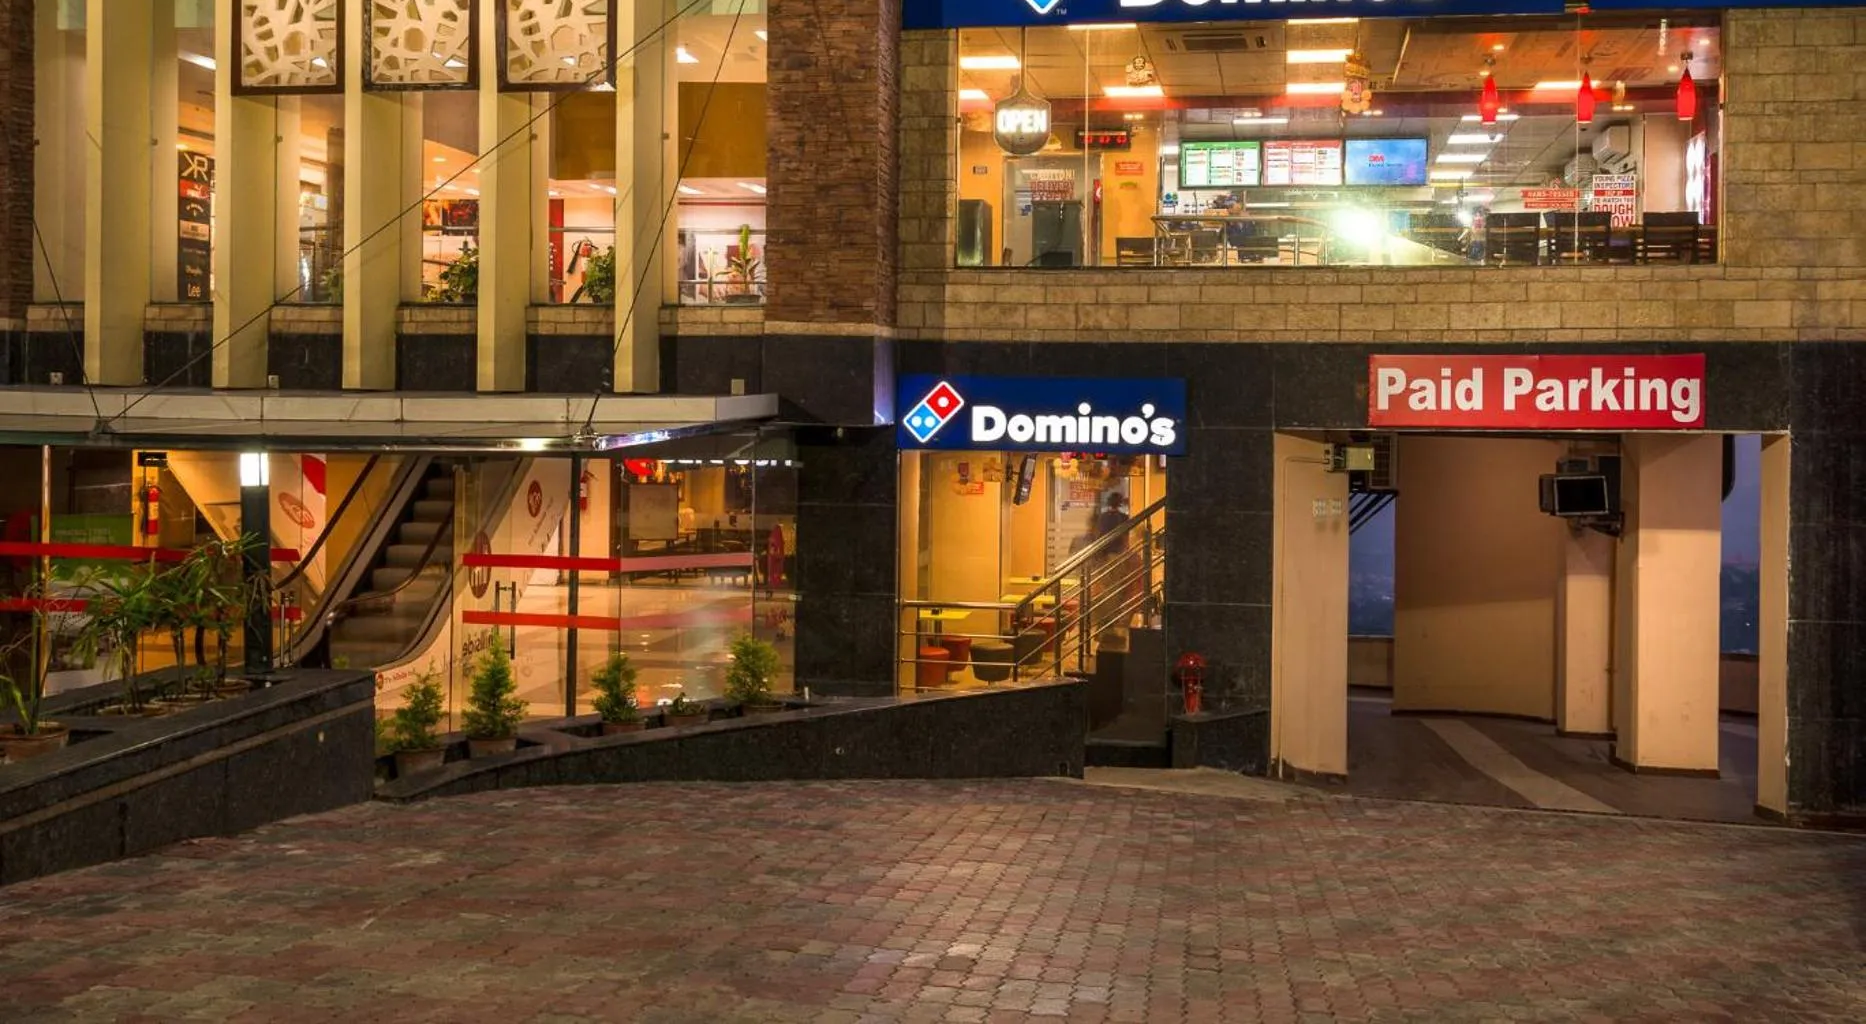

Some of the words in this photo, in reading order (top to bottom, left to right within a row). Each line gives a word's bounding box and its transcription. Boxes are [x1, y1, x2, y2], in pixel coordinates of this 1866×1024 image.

[997, 108, 1048, 134] OPEN
[187, 283, 201, 297] Lee
[1376, 367, 1484, 412] Paid
[1502, 367, 1701, 423] Parking
[971, 402, 1177, 446] Domino's
